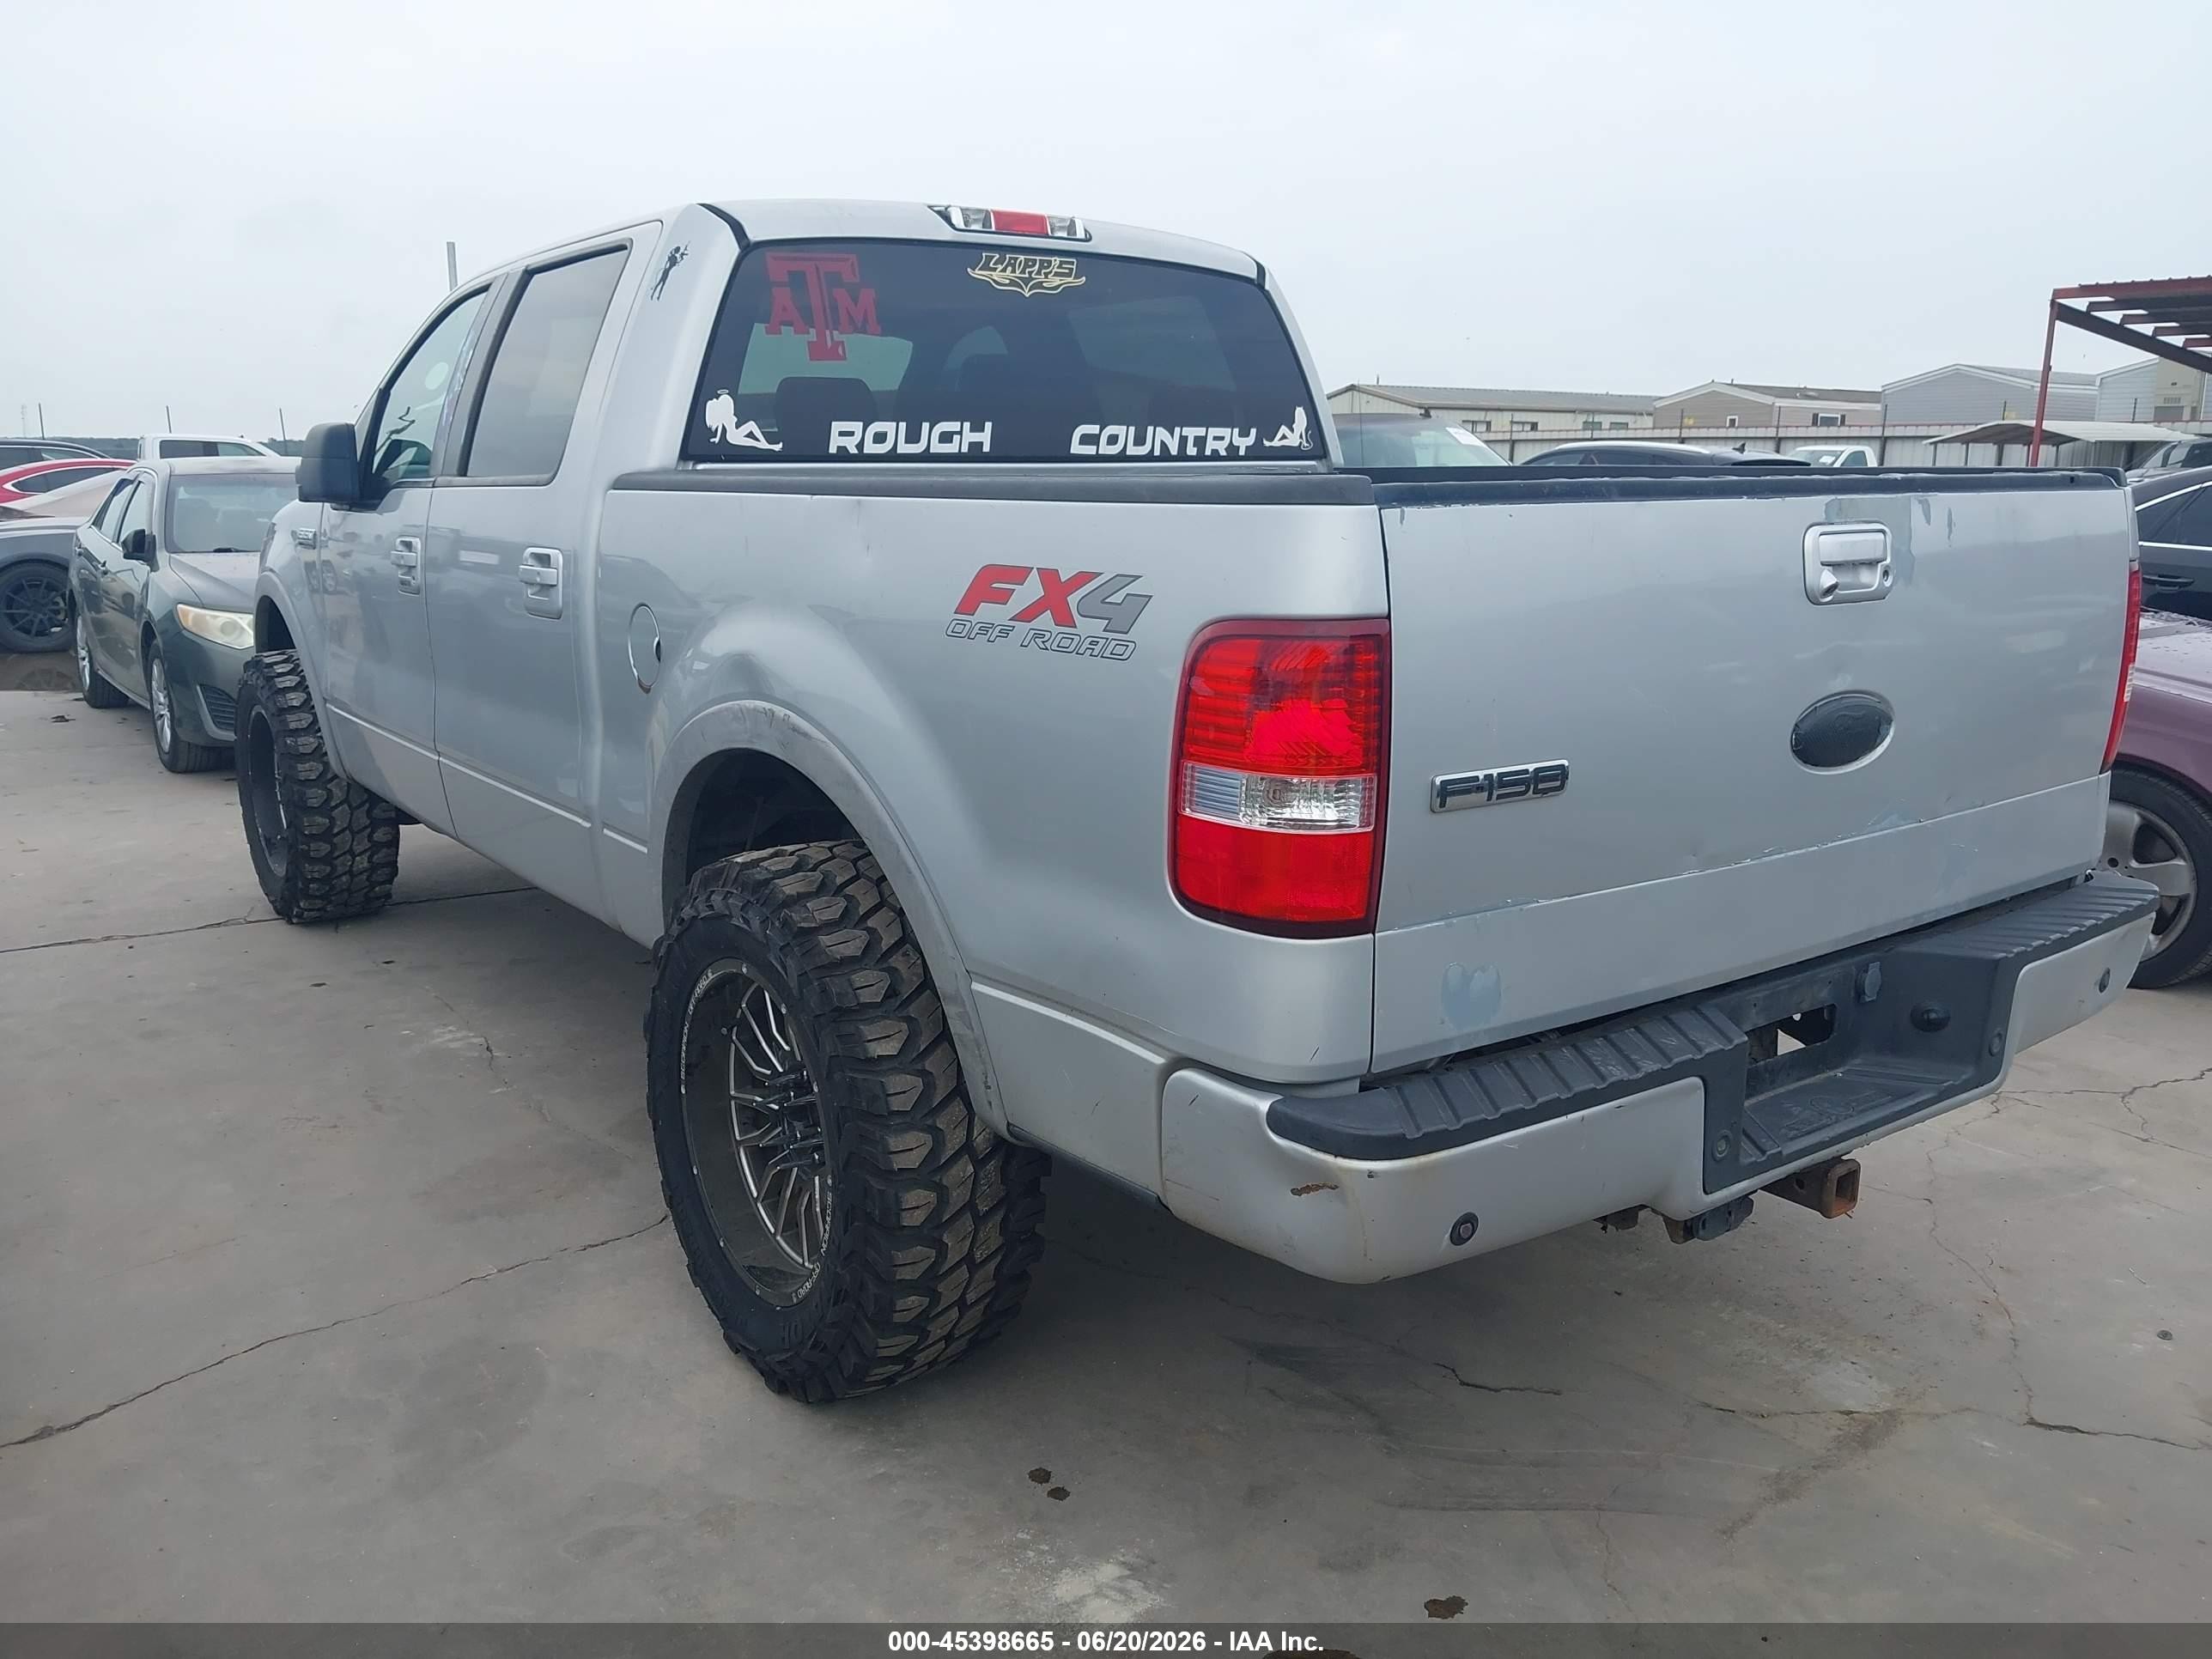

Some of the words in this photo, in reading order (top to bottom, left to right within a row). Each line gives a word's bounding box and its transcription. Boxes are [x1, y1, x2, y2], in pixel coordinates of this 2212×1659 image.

[828, 421, 993, 454] ROUGH
[1069, 424, 1257, 457] COUNTRY
[954, 563, 1154, 635] FX4
[945, 618, 1016, 643] OFF
[1019, 628, 1137, 662] ROAD
[820, 1190, 833, 1257] SCORPION
